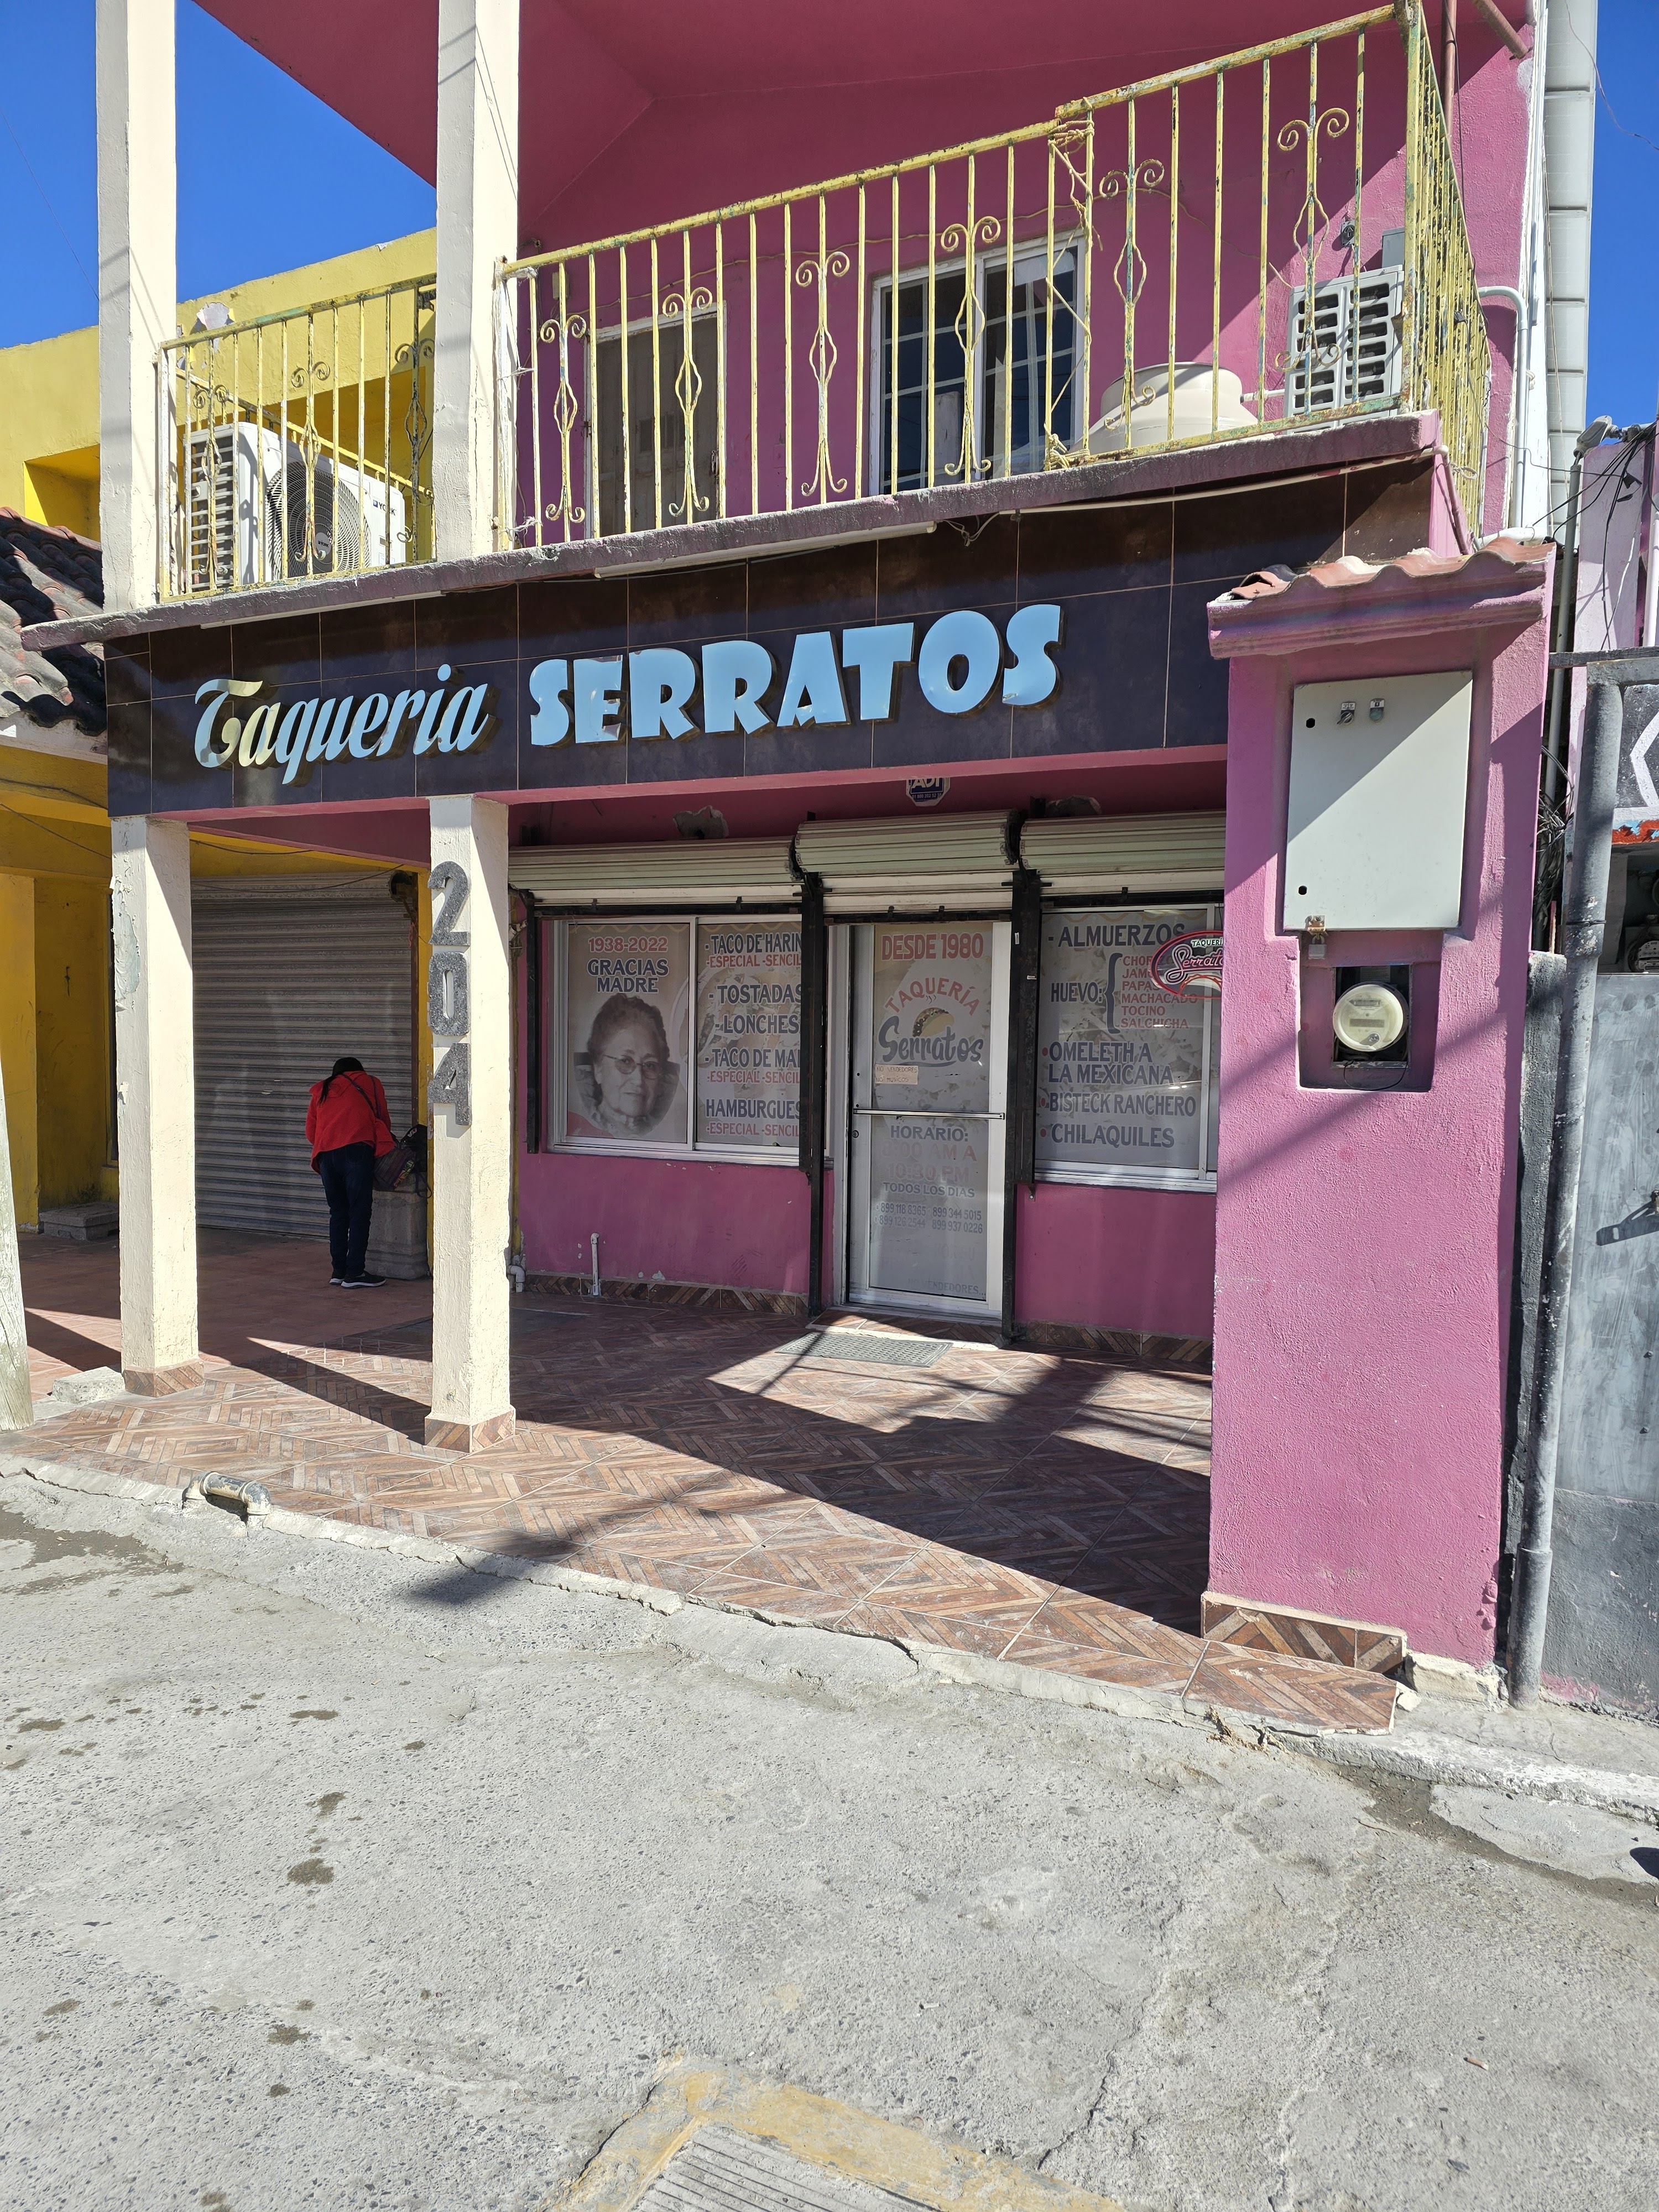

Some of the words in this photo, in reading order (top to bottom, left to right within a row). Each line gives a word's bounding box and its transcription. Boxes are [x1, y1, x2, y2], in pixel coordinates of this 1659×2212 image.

[379, 502, 395, 516] YOK
[194, 664, 489, 785] Taqueria
[529, 603, 1064, 745] SERRATOS
[589, 937, 668, 952] 1938-2022
[711, 935, 743, 954] TACO
[747, 934, 763, 953] DE
[765, 933, 801, 952] HARIN
[881, 935, 937, 961] DESDE
[941, 933, 984, 959] 1980
[1192, 938, 1223, 947] TAQUERÍ
[587, 959, 669, 976] GRACIAS
[763, 954, 801, 967] -SENCIL
[1166, 945, 1223, 983] Serrat
[1123, 969, 1154, 979] JAM
[427, 860, 472, 1126] 204
[597, 978, 658, 993] MADRE
[717, 984, 801, 1004] TOSTADAS
[885, 978, 980, 1015] TAQUERÍA
[1121, 993, 1197, 1004] MACHACADO
[1121, 1006, 1166, 1016] TOCINO
[724, 1015, 799, 1034] LONCHES
[1121, 1018, 1189, 1029] SALCHICHA
[879, 1016, 983, 1063] Serratos
[712, 1049, 749, 1067] TACO
[753, 1050, 771, 1067] DE
[775, 1050, 800, 1068] MAI
[1050, 1041, 1134, 1062] OMELETH
[1139, 1042, 1152, 1063] A
[762, 1071, 800, 1084] -SENCIL
[1048, 1064, 1072, 1083] LA
[1077, 1064, 1173, 1085] MEXICANA
[706, 1099, 800, 1119] HAMBURGUE
[1050, 1092, 1110, 1113] BISTECK
[1114, 1094, 1197, 1117] RANCHERO
[761, 1124, 799, 1137] -SENCIL
[891, 1125, 968, 1142] HORARIO:
[1051, 1123, 1175, 1148] CHILAQUILES
[929, 1143, 957, 1160] AM
[963, 1145, 977, 1161] A
[942, 1165, 970, 1182] PM
[883, 1182, 921, 1194] TODOS
[923, 1185, 945, 1196] LOS
[881, 1202, 894, 1213] 899
[896, 1203, 906, 1214] 118
[907, 1204, 926, 1216] 8365
[932, 1207, 947, 1217] 899
[963, 1209, 982, 1220] 5015
[932, 1219, 946, 1230] 899
[948, 1220, 962, 1232] 937
[963, 1222, 983, 1234] 0226
